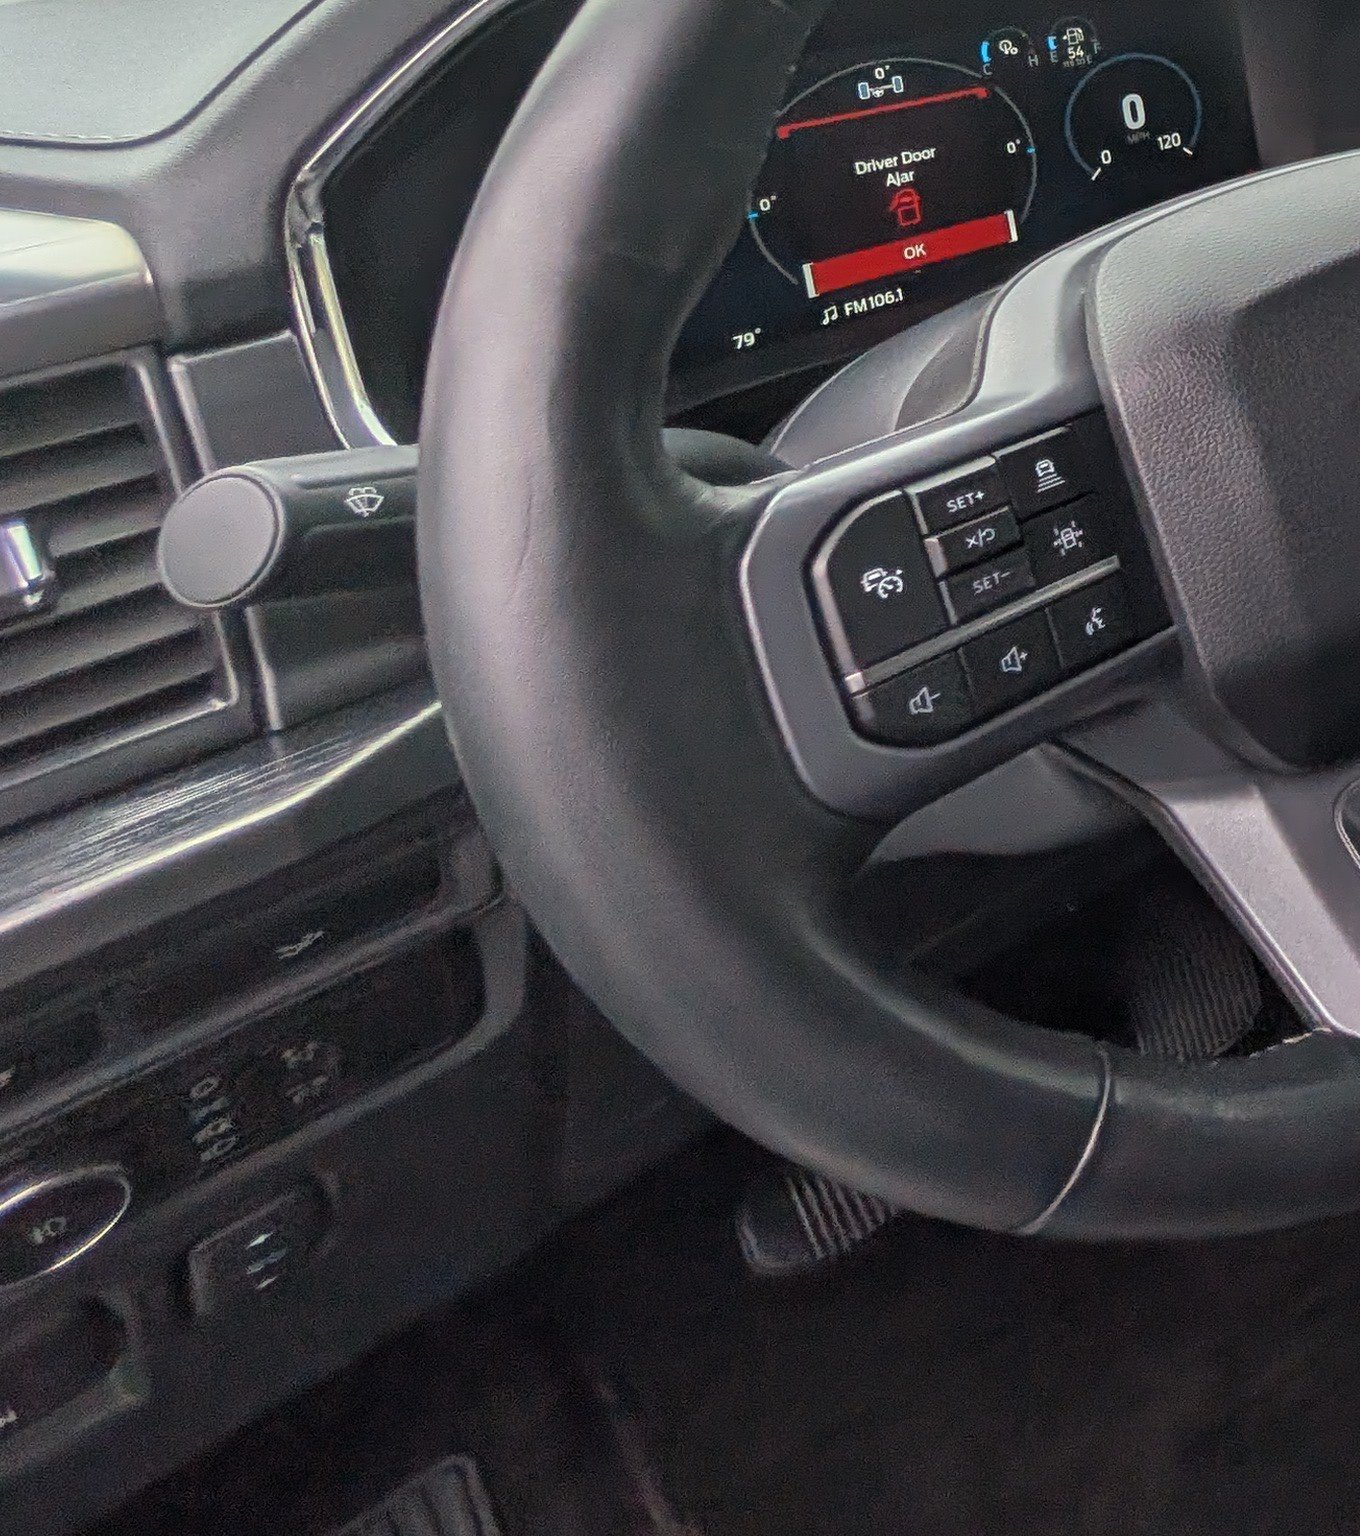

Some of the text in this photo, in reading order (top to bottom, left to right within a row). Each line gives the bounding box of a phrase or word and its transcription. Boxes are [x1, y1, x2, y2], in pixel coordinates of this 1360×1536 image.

[1028, 55, 1039, 67] H
[1067, 46, 1085, 60] 54
[983, 64, 993, 76] C
[1121, 93, 1146, 130] 0
[1157, 132, 1182, 151] 120
[854, 147, 936, 176] Driver Door
[1101, 149, 1112, 164] 0
[903, 243, 927, 260] OK
[948, 491, 985, 513] SET+
